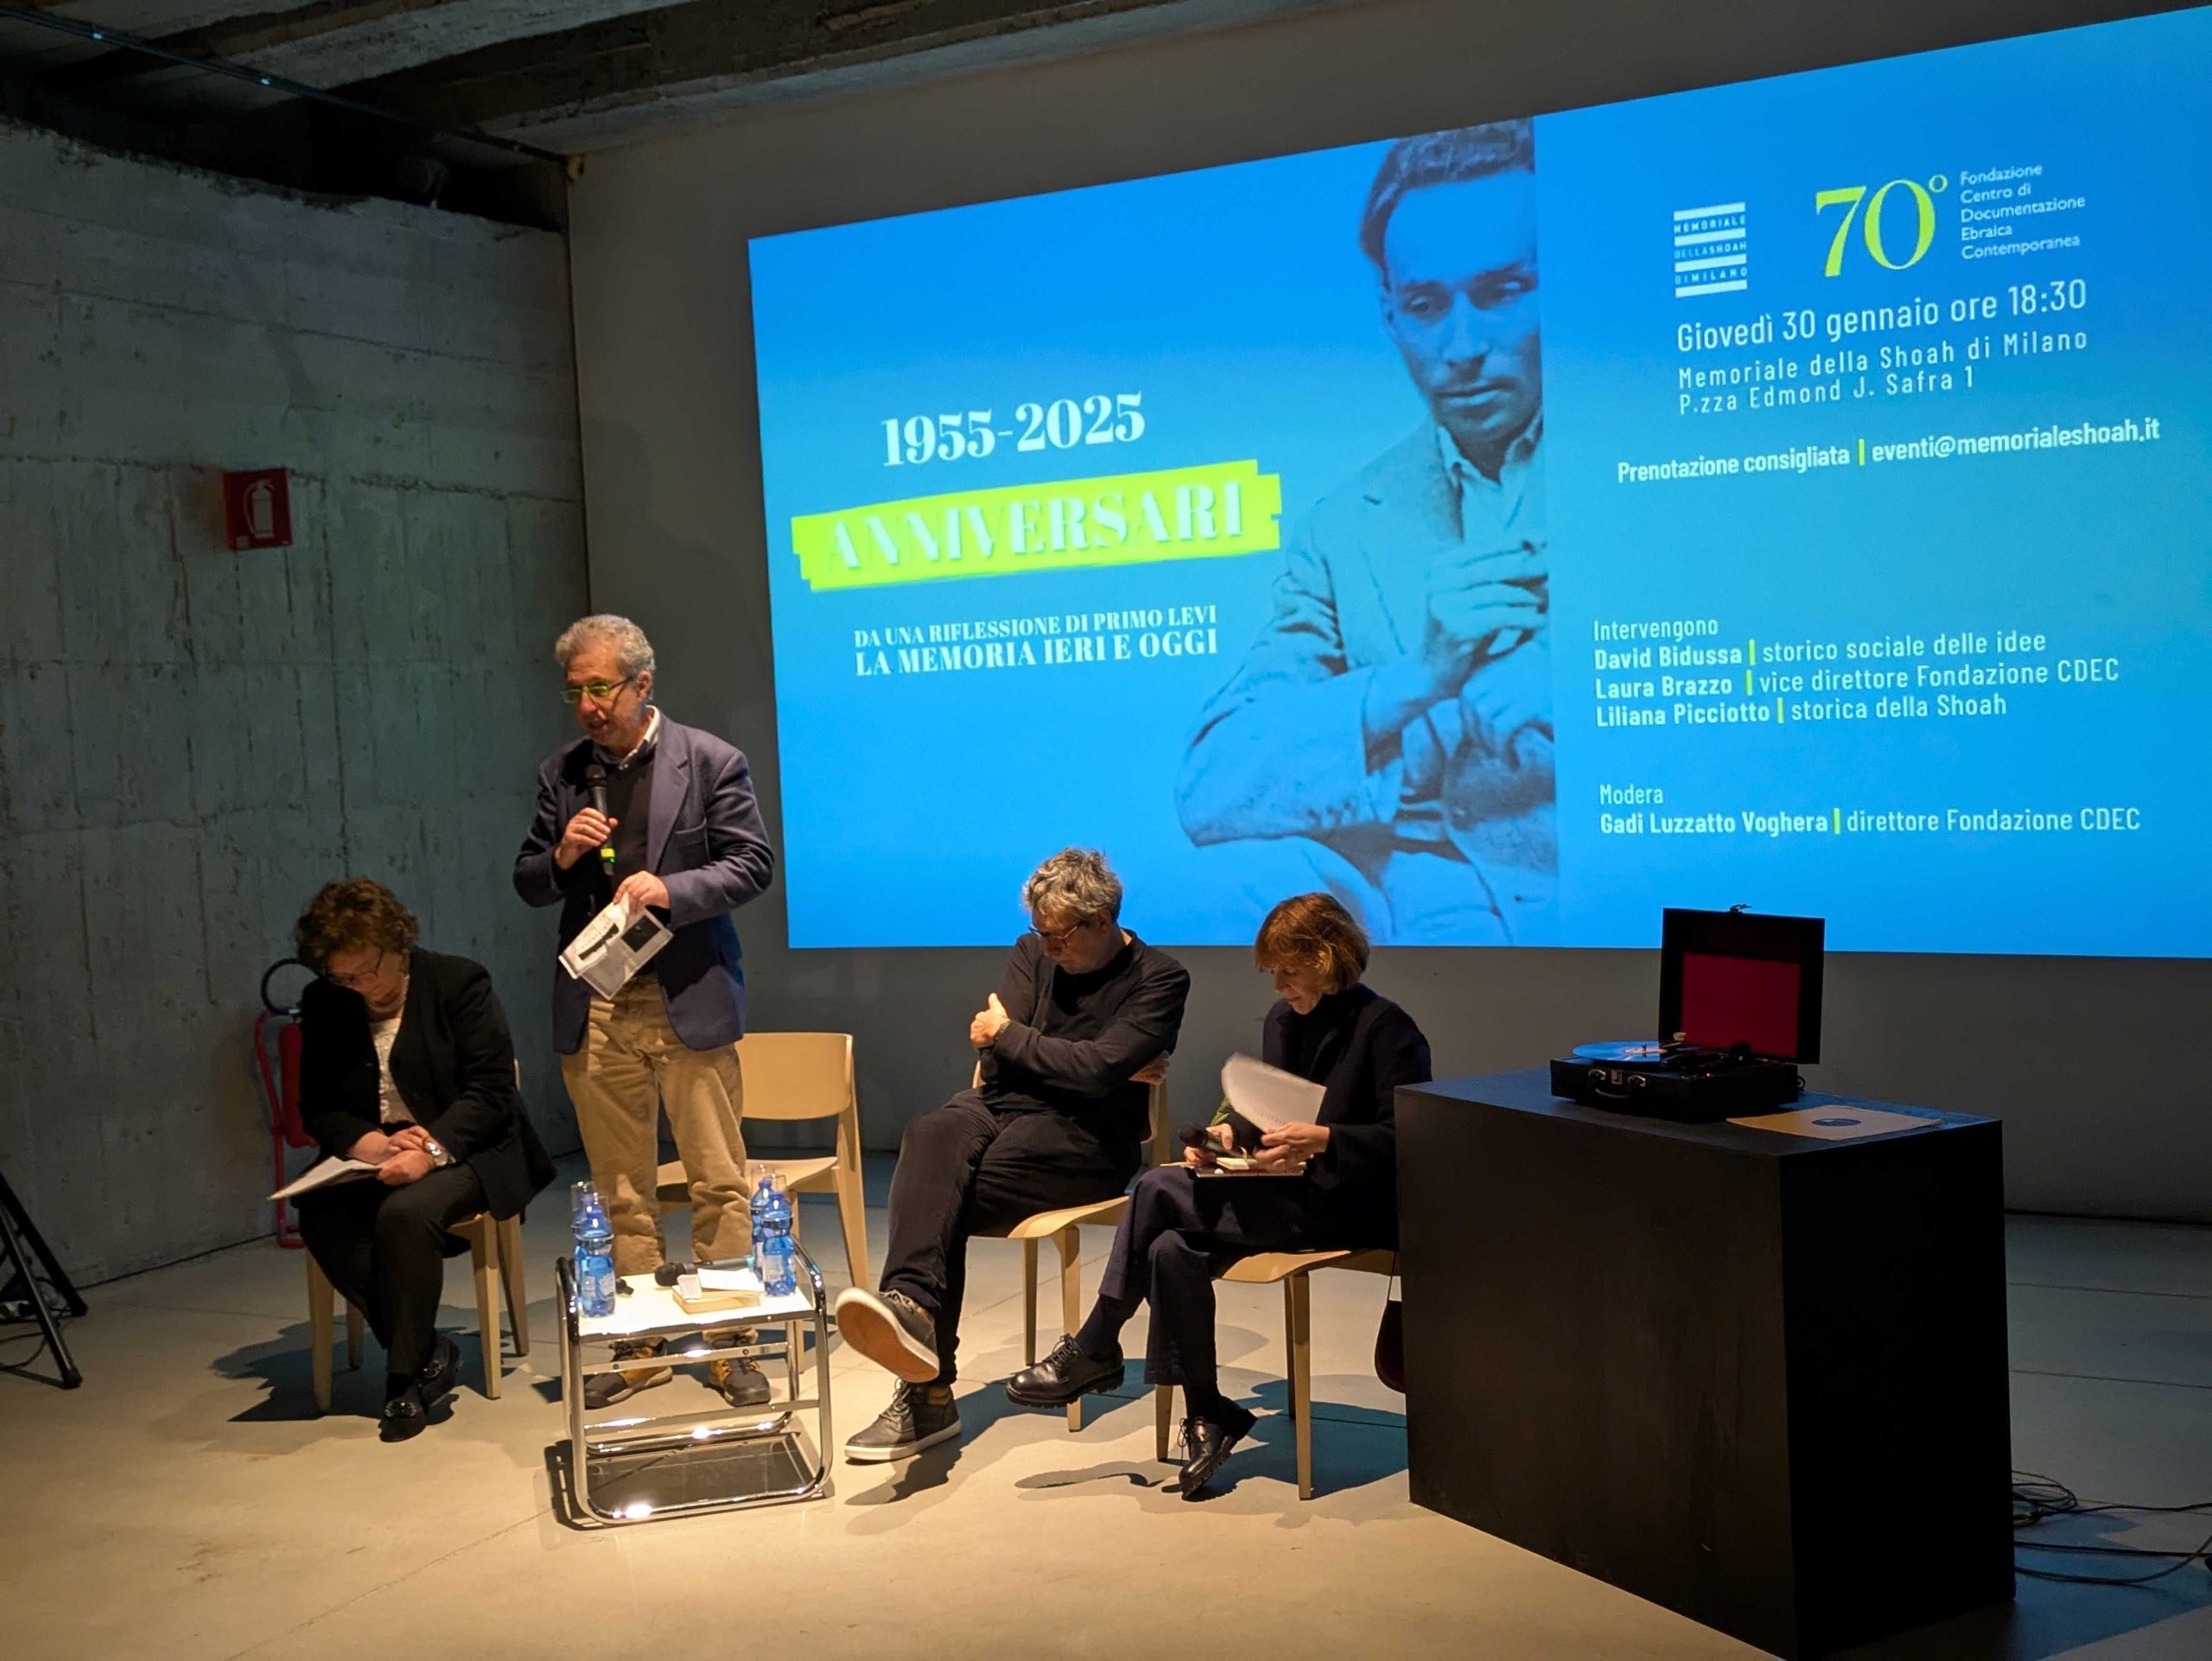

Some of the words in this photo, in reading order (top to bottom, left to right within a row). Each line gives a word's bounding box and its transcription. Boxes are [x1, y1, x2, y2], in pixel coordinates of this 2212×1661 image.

[1959, 164, 2044, 186] Fondazione
[1960, 188, 2013, 204] Centro
[2017, 182, 2031, 196] di
[1674, 214, 1745, 234] MEMORIALE
[1960, 199, 2086, 223] Documentazione
[1961, 225, 2013, 241] Ebraica
[1961, 235, 2081, 260] Contemporanea
[1677, 313, 1773, 353] Giovedì
[1783, 309, 1815, 340] 30
[1826, 296, 1939, 343] gennaio
[1950, 296, 1998, 322] ore
[2007, 278, 2087, 315] 18:30
[1678, 357, 1798, 390] Memoriale
[1809, 350, 1868, 376] della
[1879, 340, 1955, 369] Shoah
[1967, 337, 1990, 360] di
[2003, 330, 2087, 357] Milano
[1679, 391, 1738, 416] P.zza
[1750, 379, 1840, 409] Edmond
[1853, 376, 1875, 398] J.
[1885, 370, 1953, 396] Safra
[1964, 365, 1973, 388] 1
[881, 391, 1146, 467] 1955-2025
[1617, 455, 1739, 483] Prenotazione
[1743, 445, 1850, 474] consigliata
[1872, 417, 2160, 462] eventi@memorialeshoah.it
[827, 480, 1243, 571] ANNIVERSARI
[854, 629, 881, 648] DA
[885, 627, 925, 646] UNA
[929, 615, 1060, 643] RIFLESSIONE
[1065, 614, 1088, 633] DI
[1093, 608, 1163, 631] PRIMO
[1167, 604, 1217, 627] LEVI
[1593, 619, 1719, 643] Intervengono
[855, 651, 891, 677] LA
[898, 641, 1037, 673] MEMORIA
[1044, 635, 1106, 665] IERI
[1114, 634, 1131, 660] E
[1139, 628, 1217, 658] OGGI
[1594, 646, 1651, 671] David
[1658, 646, 1743, 667] Bidussa
[1763, 639, 1838, 663] storico
[1846, 634, 1924, 659] sociale
[1933, 632, 1987, 655] delle
[1997, 630, 2046, 653] idee
[1595, 678, 1655, 700] Laura
[1662, 675, 1732, 697] Brazzo
[1759, 671, 1803, 692] vice
[1811, 669, 1909, 691] direttore
[1916, 662, 2049, 687] Fondazione
[2057, 658, 2120, 683] CDEC
[1596, 705, 1666, 728] Liliana
[1674, 702, 1770, 724] Picciotto
[1791, 697, 1868, 721] storica
[1875, 696, 1929, 718] della
[1936, 692, 2007, 716] Shoah
[1599, 783, 1664, 805] Modera
[1600, 812, 1644, 834] Gadi
[1649, 812, 1736, 834] Luzzatto
[1741, 811, 1828, 838] Voghera
[1847, 810, 1940, 832] direttore
[1947, 808, 2073, 831] Fondazione
[2080, 807, 2141, 830] CDEC
